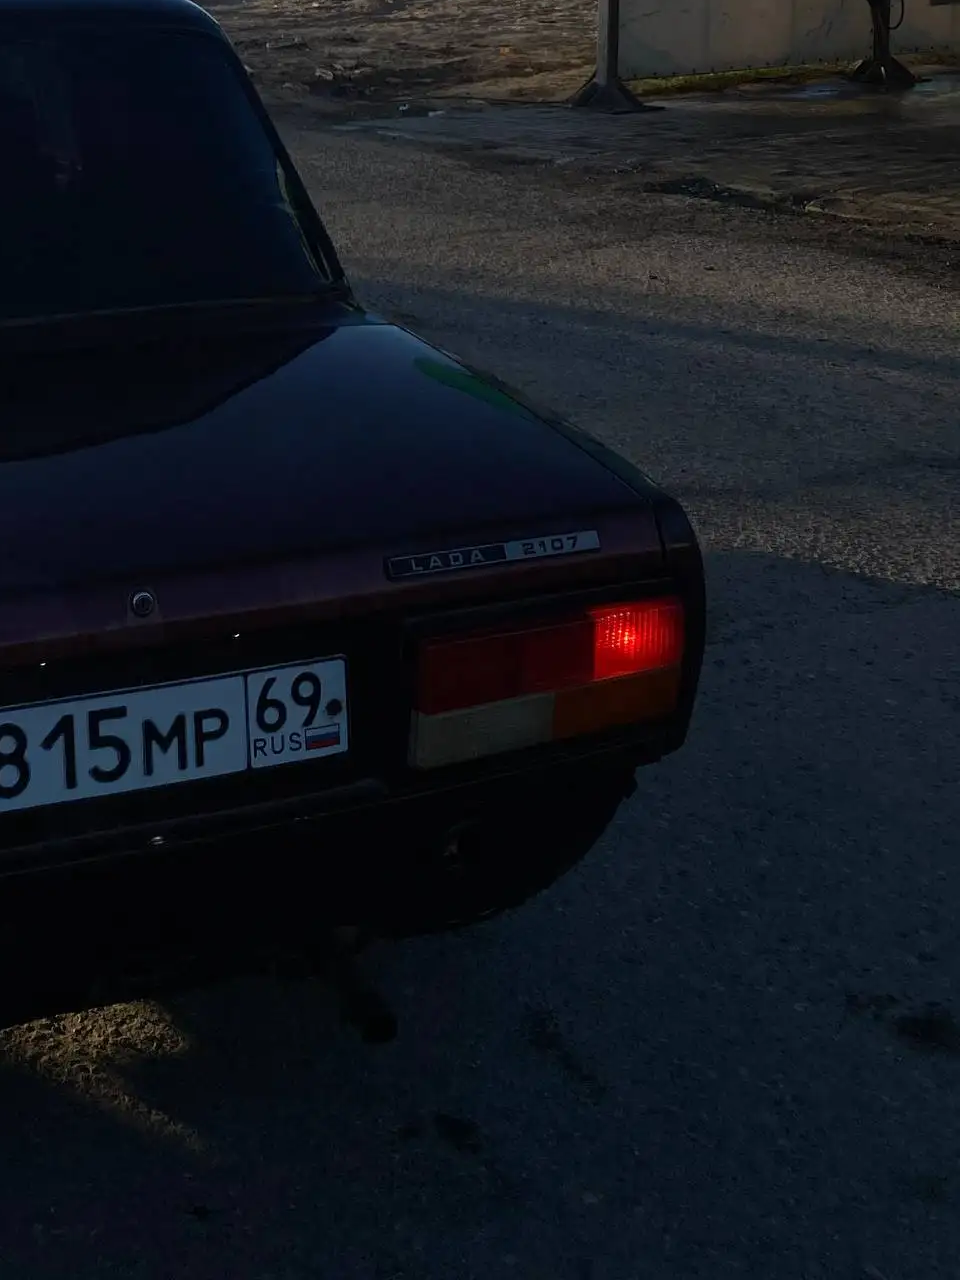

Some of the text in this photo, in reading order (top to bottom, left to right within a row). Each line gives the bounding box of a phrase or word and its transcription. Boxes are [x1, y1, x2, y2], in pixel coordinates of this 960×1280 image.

[410, 535, 578, 572] LADA 2107
[255, 671, 322, 733] 69
[252, 730, 303, 759] RUS
